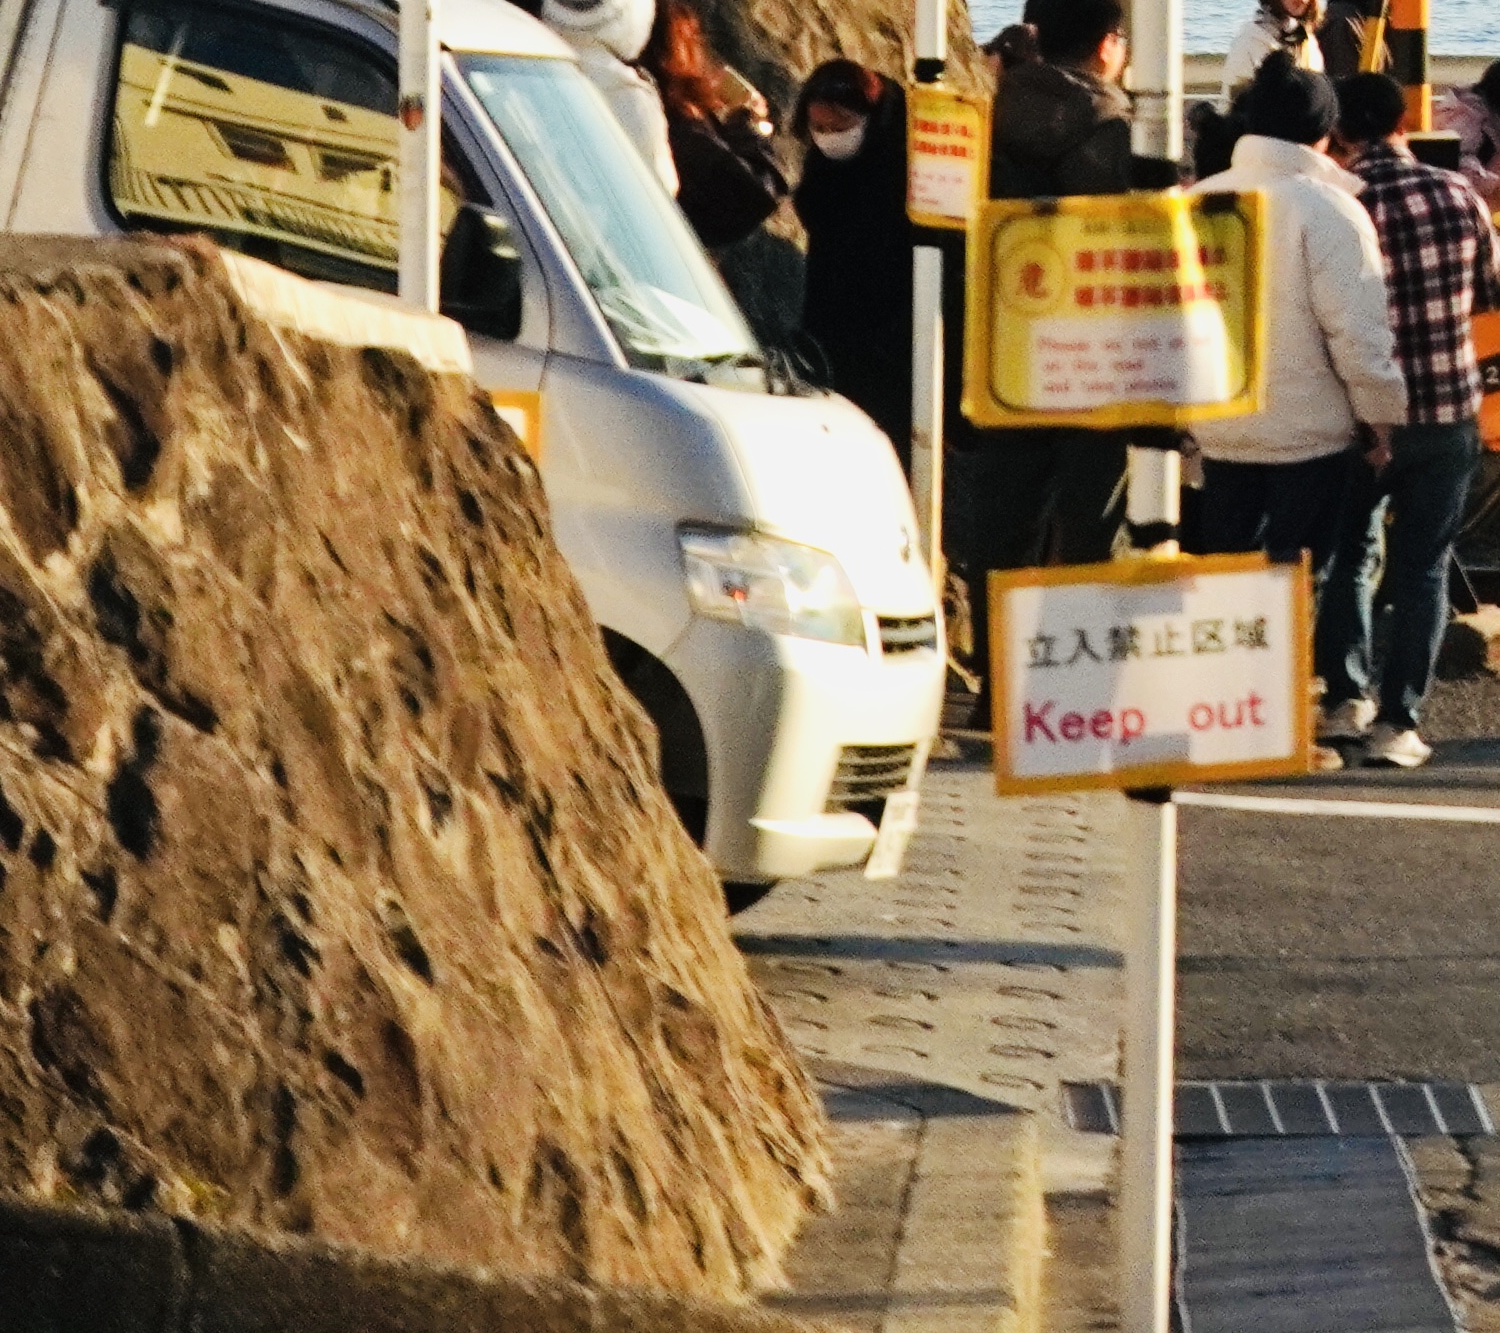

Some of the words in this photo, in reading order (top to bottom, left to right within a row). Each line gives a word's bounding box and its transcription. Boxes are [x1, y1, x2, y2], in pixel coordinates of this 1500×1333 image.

[1027, 617, 1269, 667] 立入禁止区域
[1023, 699, 1146, 745] Keep
[1188, 690, 1265, 732] out
